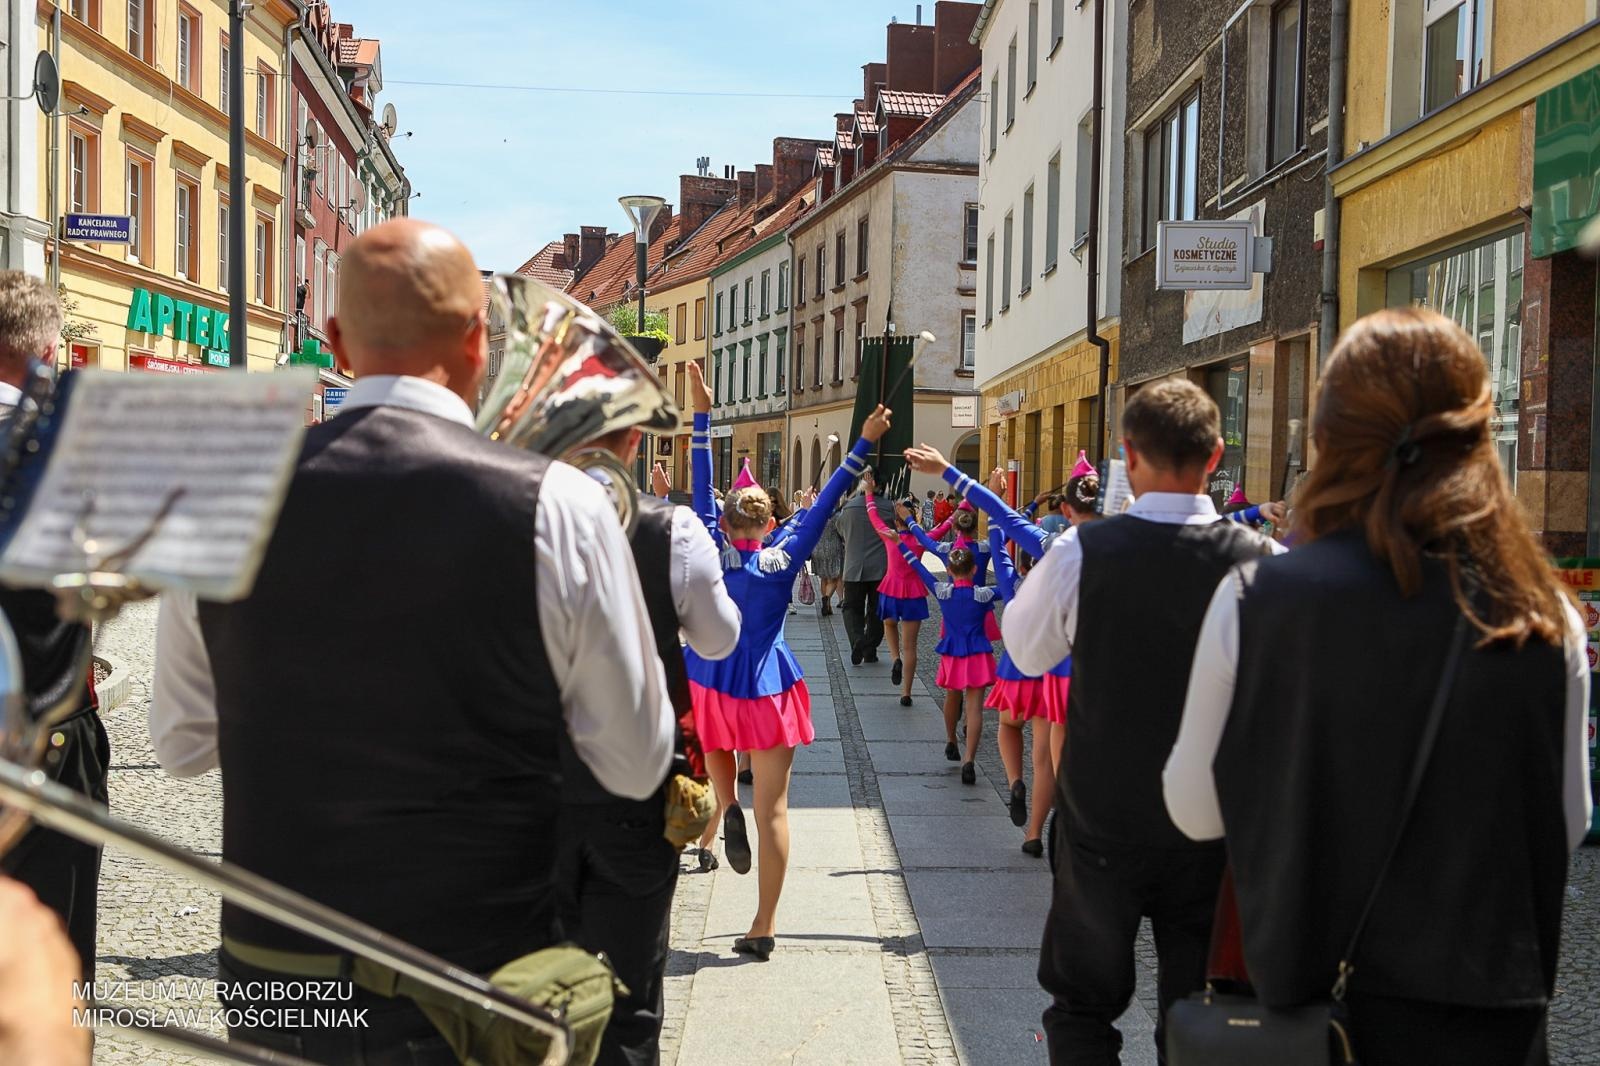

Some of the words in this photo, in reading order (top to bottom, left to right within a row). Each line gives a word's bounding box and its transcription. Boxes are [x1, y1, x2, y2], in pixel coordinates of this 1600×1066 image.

[78, 217, 117, 228] KANCELARIA
[67, 228, 89, 238] RADCY
[90, 229, 128, 240] PRAWNEGO
[1197, 236, 1238, 249] Studio
[1173, 249, 1237, 260] KOSMETYCZNE
[127, 288, 230, 352] APTEK
